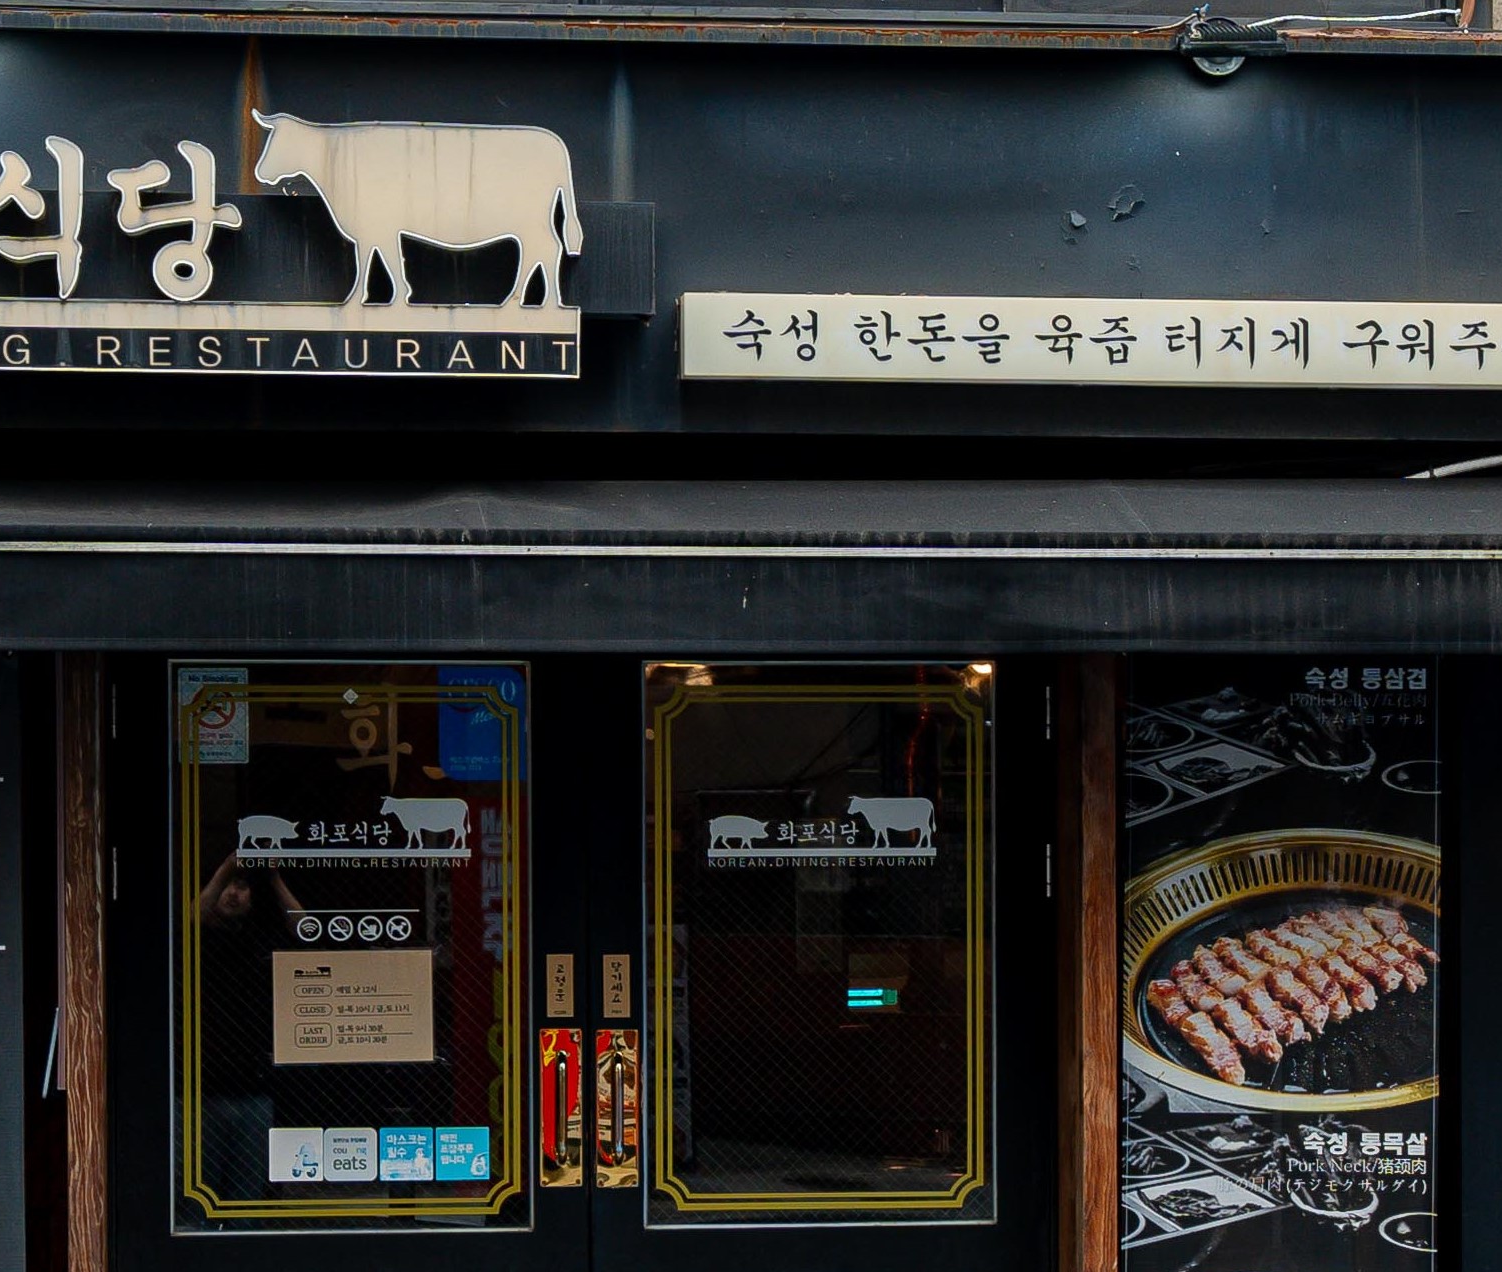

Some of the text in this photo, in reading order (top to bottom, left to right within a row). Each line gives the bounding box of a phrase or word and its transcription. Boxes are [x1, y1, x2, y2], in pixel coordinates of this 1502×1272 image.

[721, 308, 821, 363] 숙성
[853, 309, 1011, 365] 한돈을
[1034, 313, 1139, 364] 육즙
[1165, 314, 1312, 371] 터지게
[1305, 667, 1349, 689] 숙성
[307, 820, 393, 846] 화포식당
[777, 820, 860, 844] 화포식당
[299, 1036, 327, 1044] ORDER
[333, 1147, 367, 1155] coung
[1303, 1132, 1428, 1155] 숙성 통목살
[333, 1156, 367, 1170] eats
[1288, 1158, 1324, 1173] Pork
